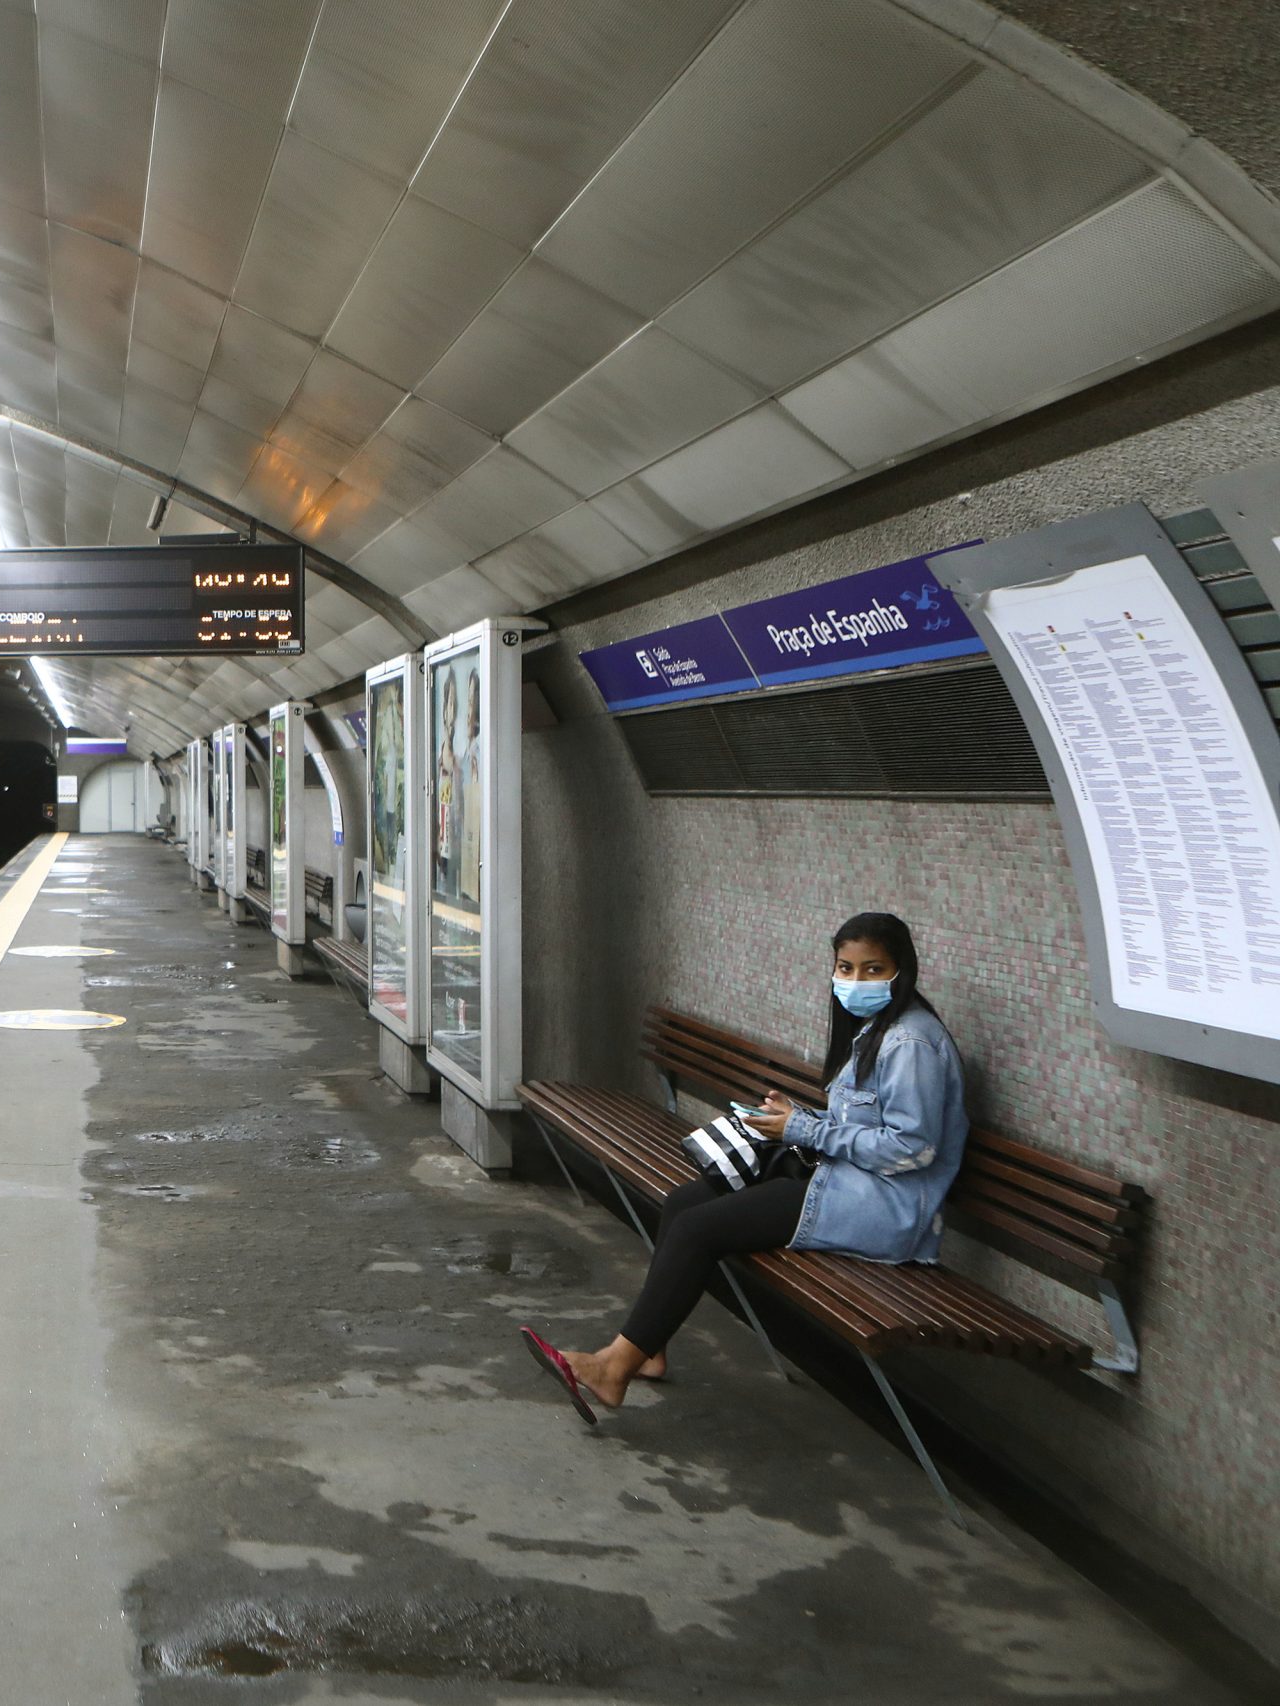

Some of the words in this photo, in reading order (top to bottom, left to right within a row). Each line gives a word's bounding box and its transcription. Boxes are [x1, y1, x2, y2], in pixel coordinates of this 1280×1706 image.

[212, 610, 243, 619] TEMPO
[244, 610, 257, 618] DE
[257, 609, 292, 619] ESPERA
[766, 624, 815, 657] Praça
[809, 613, 837, 645] de
[826, 598, 909, 647] Espanha
[503, 633, 519, 646] 12
